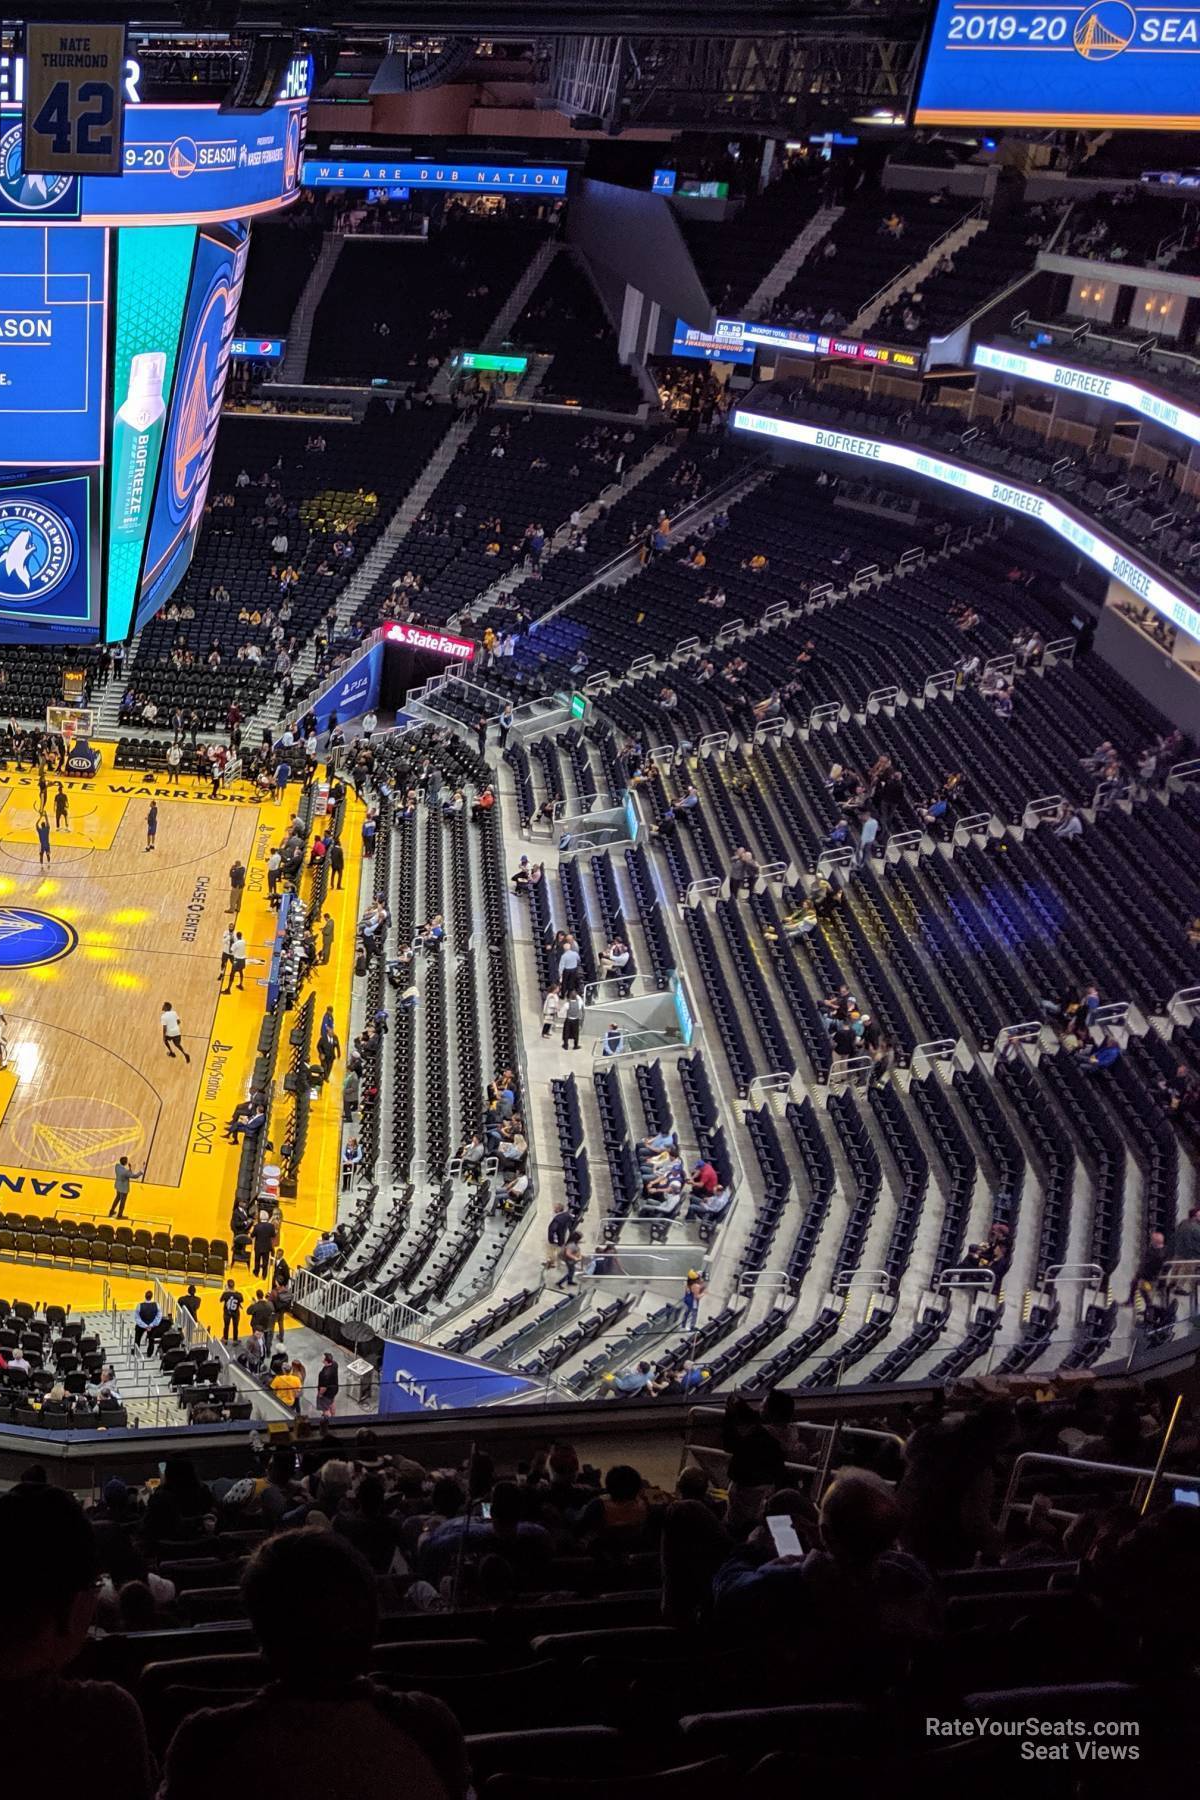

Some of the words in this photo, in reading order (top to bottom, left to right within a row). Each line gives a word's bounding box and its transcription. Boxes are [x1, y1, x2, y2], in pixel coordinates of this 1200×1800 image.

[947, 15, 1068, 41] 2019-20
[1139, 18, 1198, 43] SEA
[59, 38, 91, 51] NATE
[41, 54, 109, 68] THURMOND
[31, 81, 115, 155] 42
[200, 147, 238, 164] SEASON
[320, 168, 345, 178] WE
[363, 169, 402, 179] ARE
[420, 170, 459, 181] DUB
[477, 172, 560, 185] NATION
[893, 353, 915, 365] FINAL
[69, 757, 92, 769] KIA
[18, 774, 97, 792] SATE
[108, 784, 264, 805] WARRIORS
[196, 876, 211, 905] CHASE
[180, 908, 202, 943] CENTER
[395, 1369, 450, 1411] CHA
